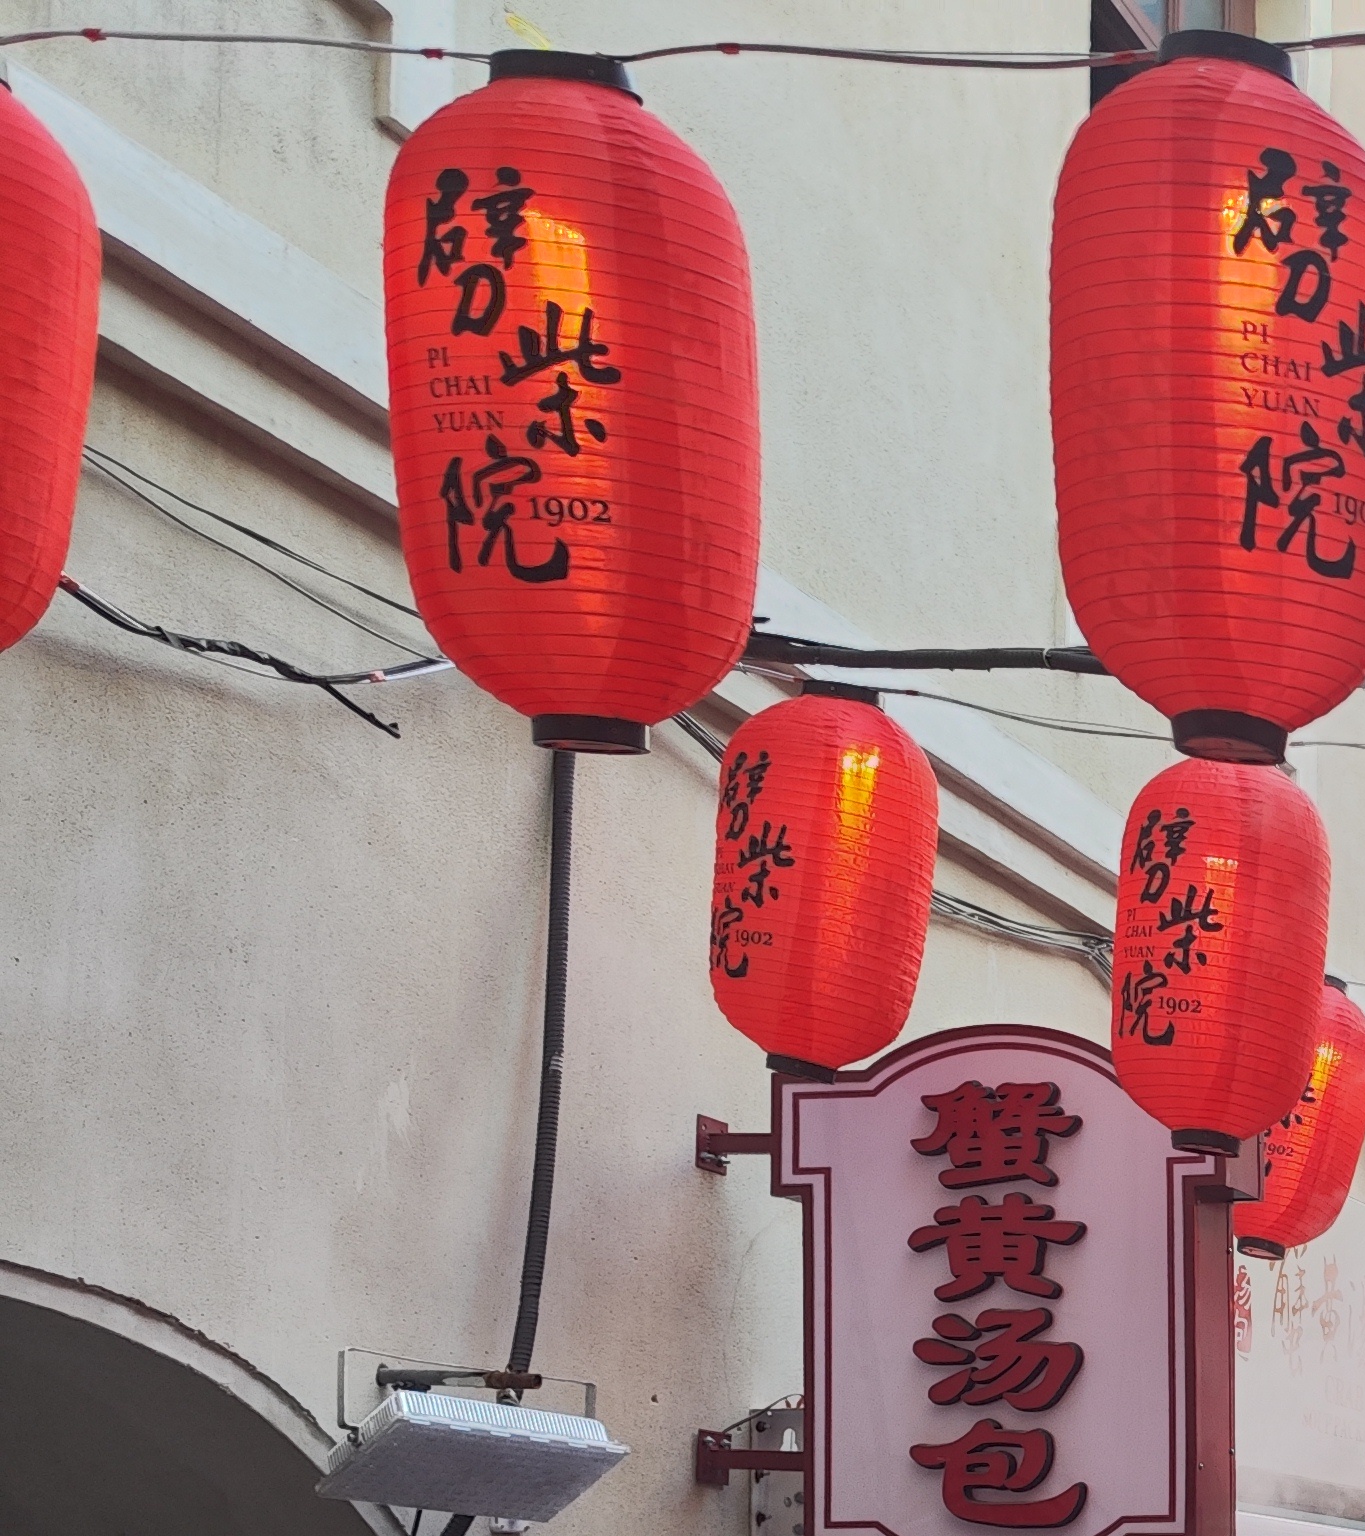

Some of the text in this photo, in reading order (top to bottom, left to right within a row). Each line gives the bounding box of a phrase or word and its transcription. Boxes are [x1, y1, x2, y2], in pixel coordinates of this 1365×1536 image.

[1242, 320, 1270, 344] PI
[427, 347, 449, 370] PI
[1241, 350, 1313, 382] CHAI
[417, 166, 622, 584] 劈柴院
[430, 373, 492, 401] CHAI
[1241, 387, 1320, 418] YUAN
[433, 408, 505, 434] YUAN
[528, 495, 613, 526] 1902
[709, 751, 796, 979] 劈柴院
[1119, 808, 1223, 1047] 劈柴院
[1126, 908, 1137, 922] PI
[734, 929, 774, 947] 1902
[1124, 924, 1154, 939] CHAI
[1122, 944, 1155, 960] YUAN
[1157, 995, 1203, 1015] 1902
[907, 1080, 1088, 1528] 蟹黄汤包
